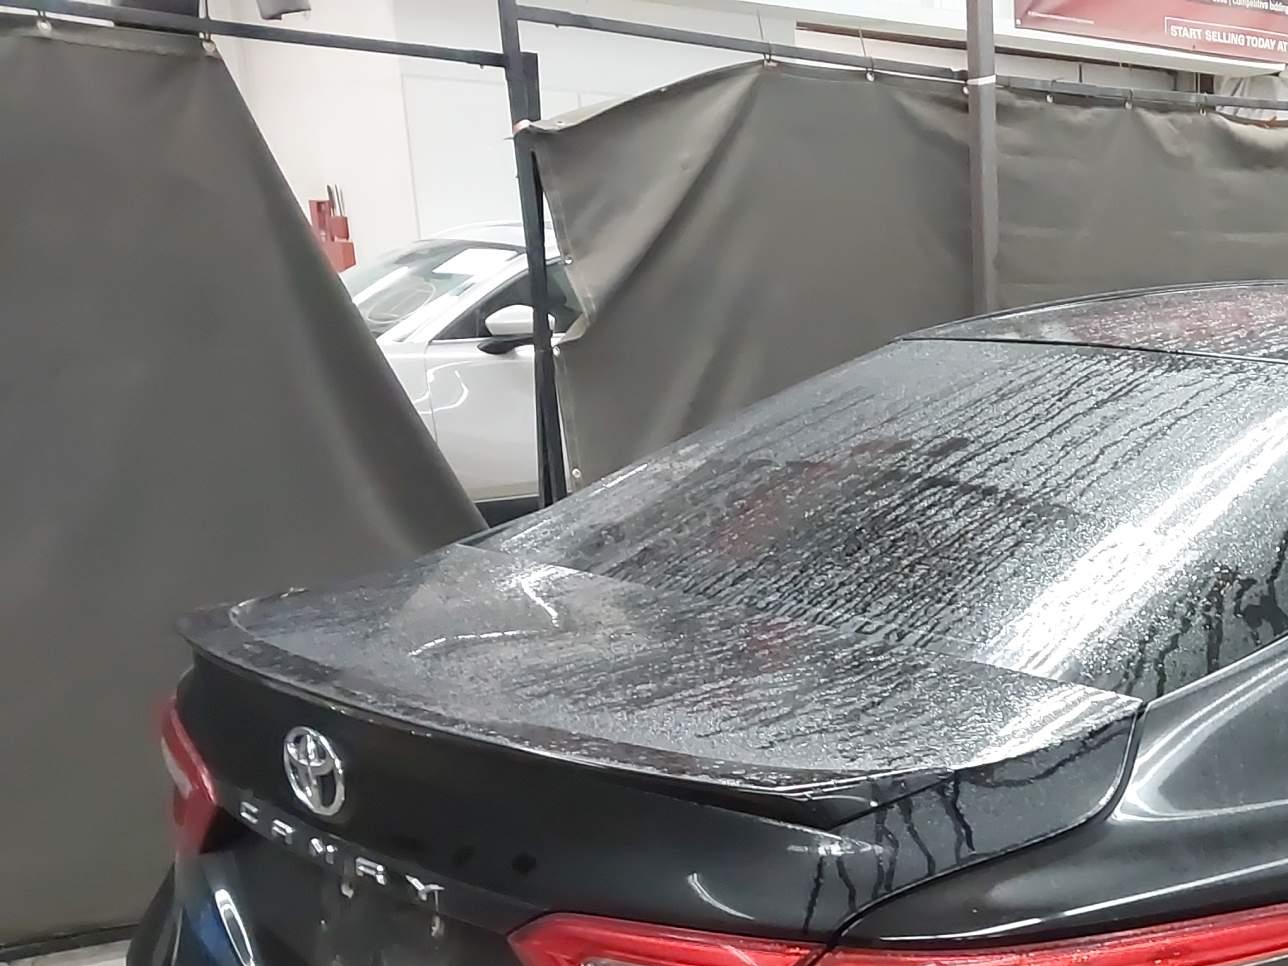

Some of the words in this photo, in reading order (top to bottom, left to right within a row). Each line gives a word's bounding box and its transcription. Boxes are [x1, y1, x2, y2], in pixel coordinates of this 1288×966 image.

[1170, 25, 1202, 39] START
[1205, 29, 1245, 46] SELLING
[1246, 36, 1277, 51] TODAY
[1277, 40, 1288, 53] AT
[240, 801, 445, 901] CAMRY
